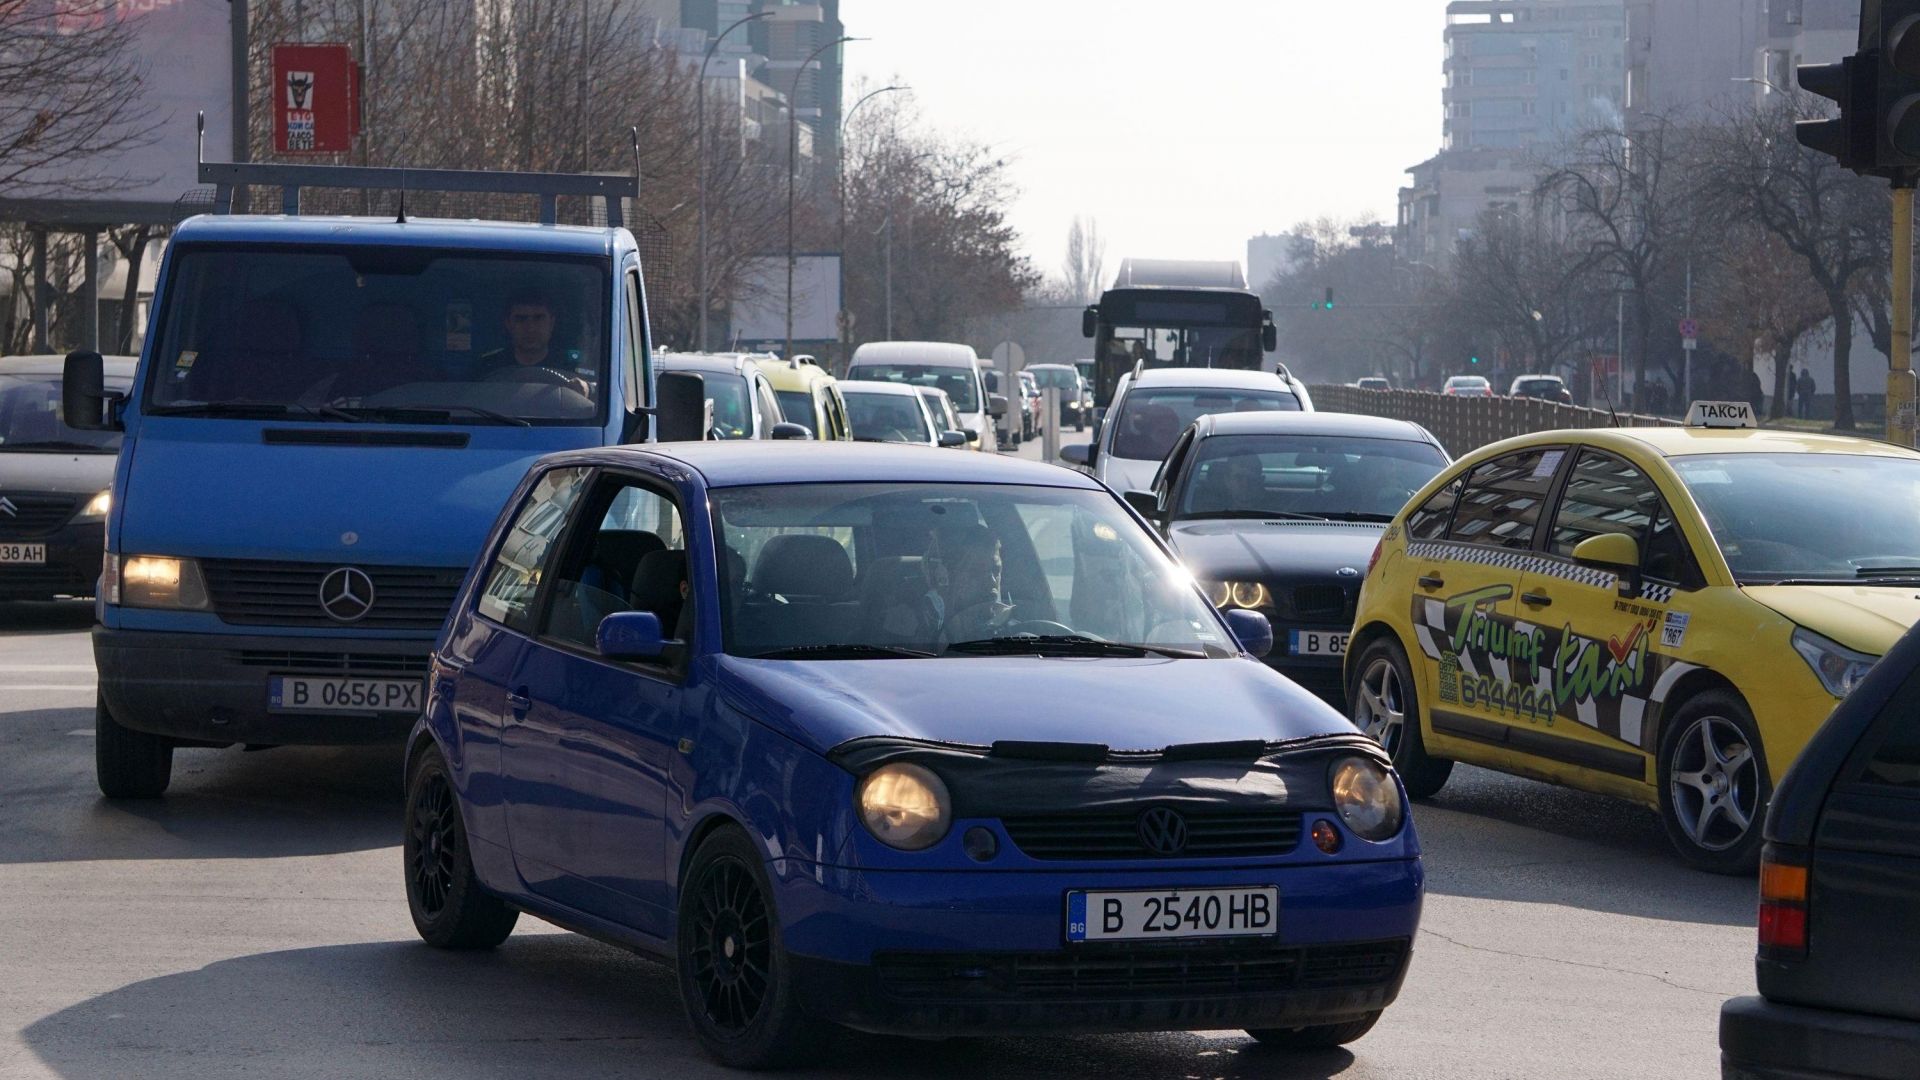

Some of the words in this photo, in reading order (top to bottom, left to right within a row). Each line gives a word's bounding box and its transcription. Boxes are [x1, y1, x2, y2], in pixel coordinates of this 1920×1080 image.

[1699, 404, 1748, 419] ТАКСИ
[0, 546, 20, 560] 38
[1307, 633, 1320, 653] B
[1446, 584, 1546, 684] Triumf
[1552, 618, 1656, 706] taxi
[1663, 627, 1683, 645] 7867
[293, 681, 310, 705] B
[322, 682, 380, 707] 0656
[385, 684, 417, 708] PX
[1460, 670, 1557, 728] 644444
[1103, 898, 1124, 933] B
[1142, 895, 1222, 932] 2540
[1229, 893, 1271, 929] HB
[1070, 922, 1085, 934] BG
